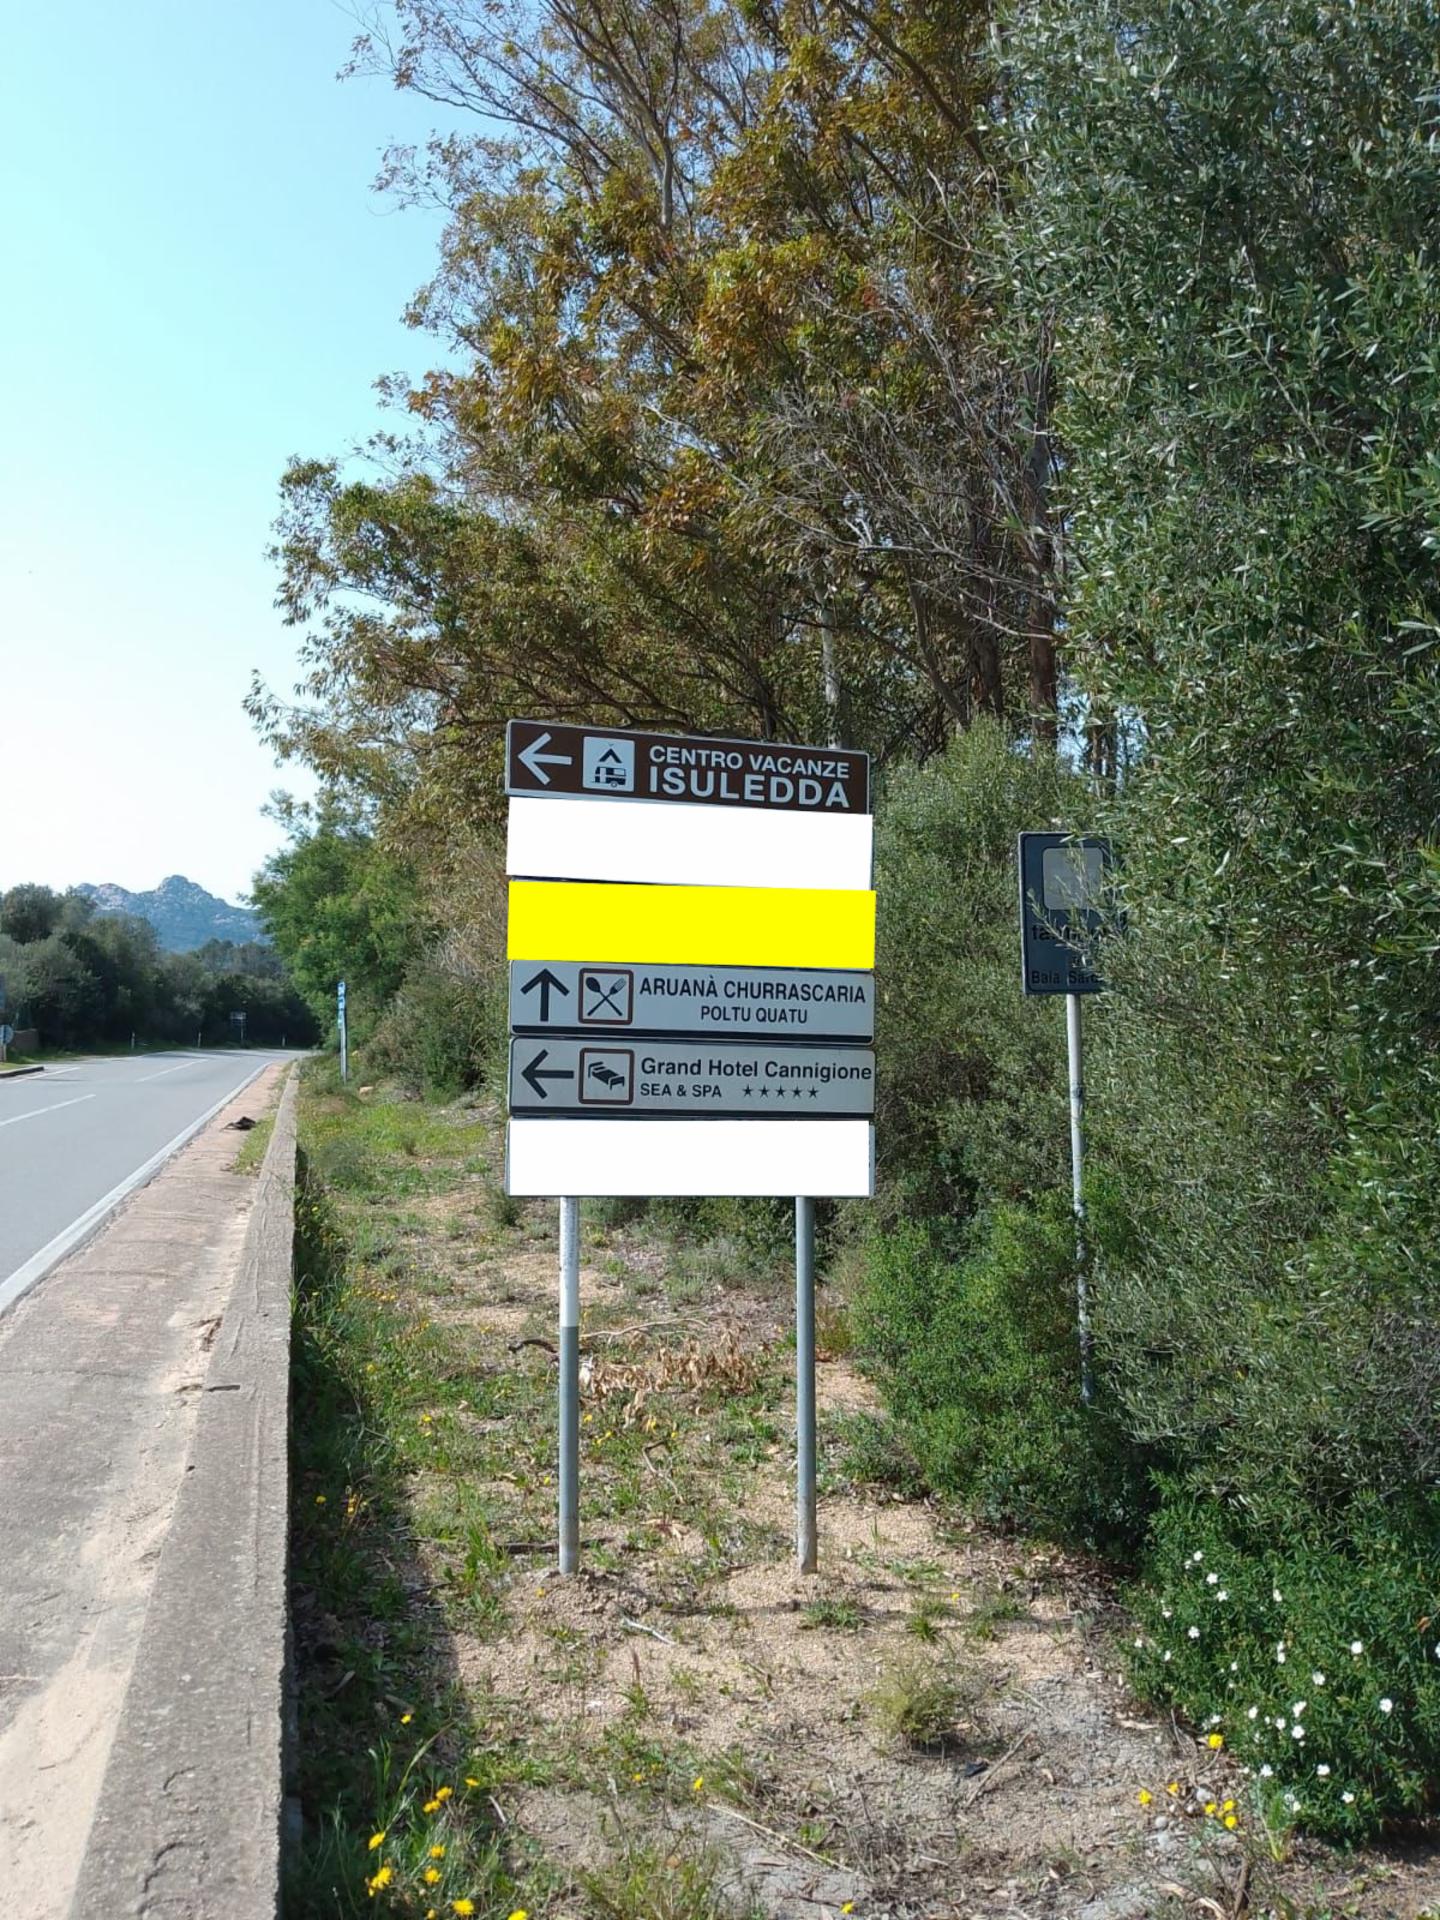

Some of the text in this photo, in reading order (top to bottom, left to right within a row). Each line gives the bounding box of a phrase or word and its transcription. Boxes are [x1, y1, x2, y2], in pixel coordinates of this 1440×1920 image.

[649, 745, 850, 779] CENTRO VACANZE
[649, 766, 850, 807] ISULEDDA
[639, 975, 866, 1003] ARUANÀ CHURRASCARIA
[700, 1005, 808, 1024] POLTU QUATU
[640, 1057, 872, 1083] Grand Hotel Cannigione
[640, 1083, 722, 1097] SEA & SPA
